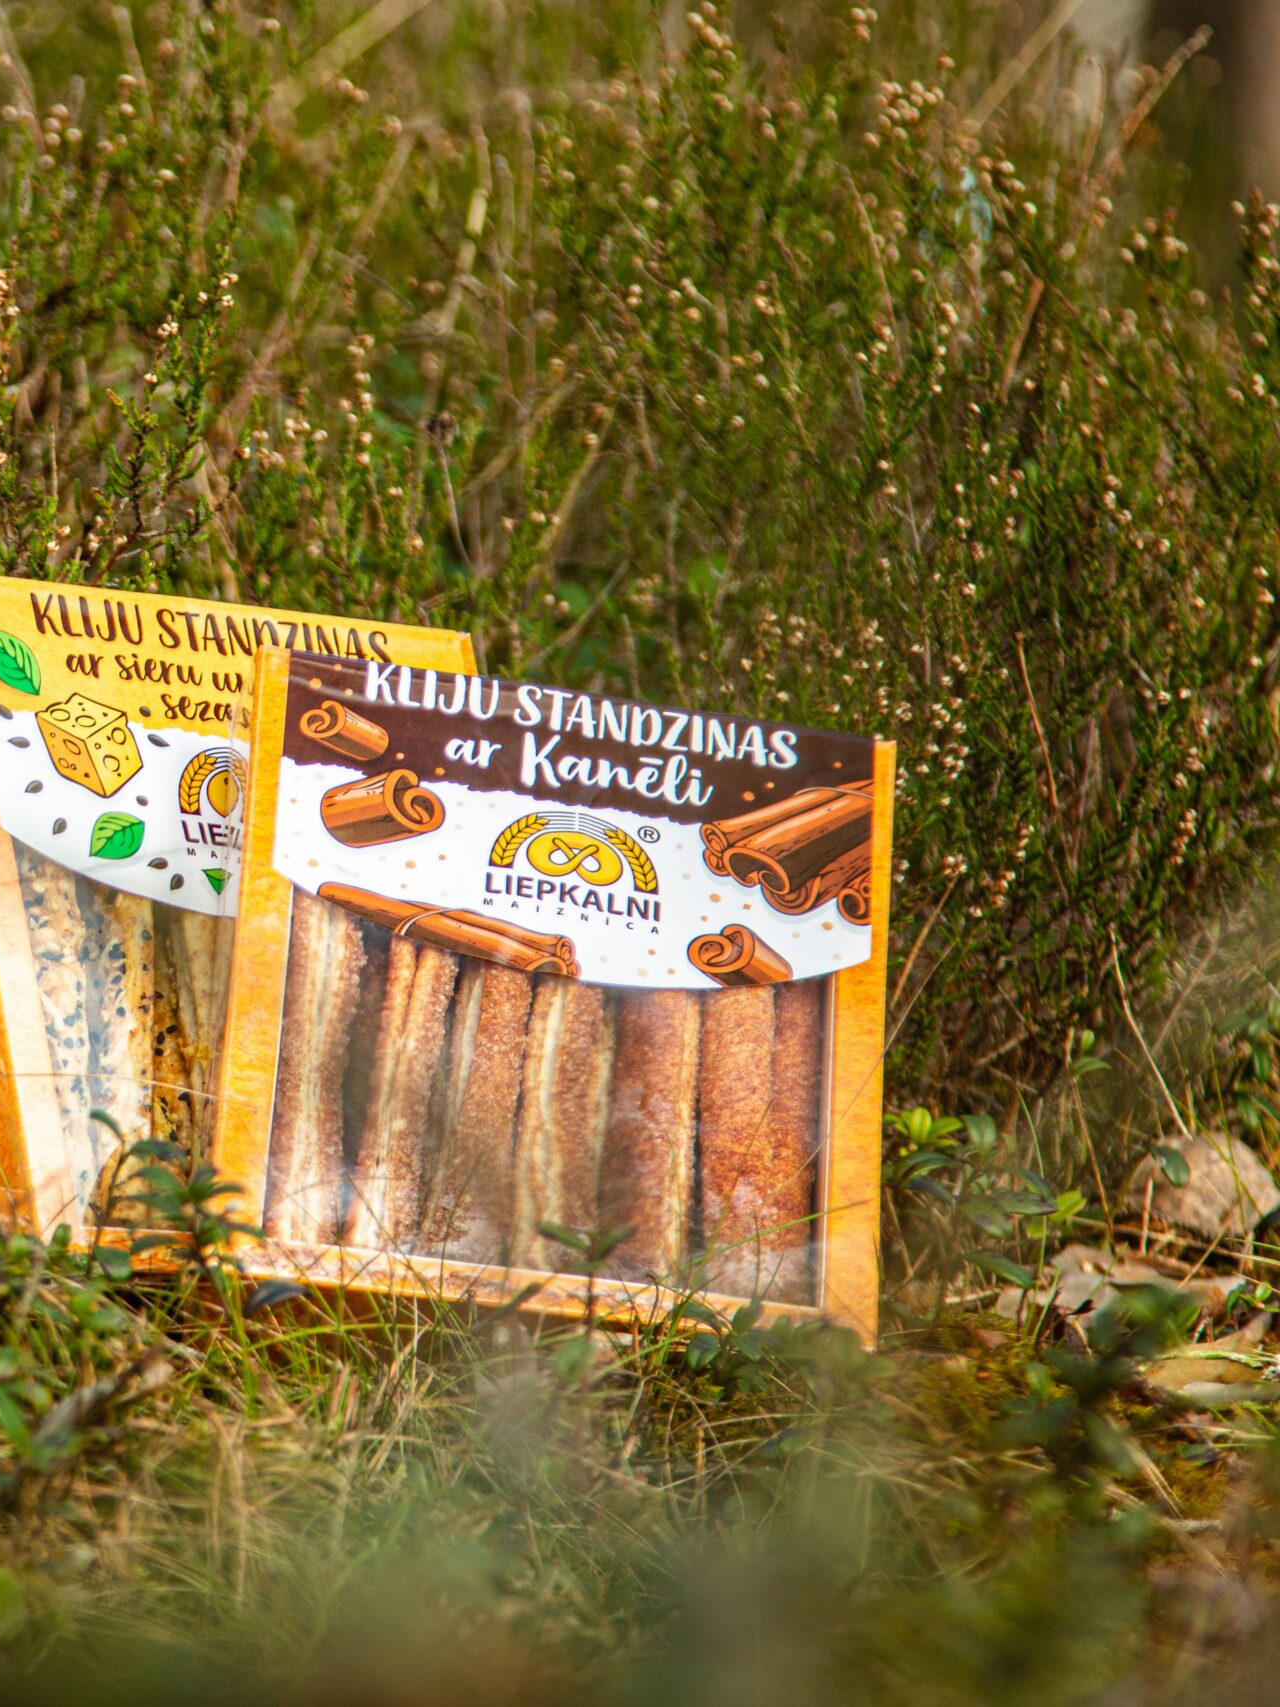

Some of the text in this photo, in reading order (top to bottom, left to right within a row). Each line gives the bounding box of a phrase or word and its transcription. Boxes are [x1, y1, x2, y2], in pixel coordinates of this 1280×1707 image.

[30, 592, 144, 646] KLIJU
[66, 653, 104, 678] ar
[114, 653, 203, 685] sieru
[160, 693, 234, 722] seza
[363, 660, 799, 769] KLIJU STANDZIŅAS
[443, 731, 714, 806] ar Kanēli
[484, 871, 662, 923] LIEPKALNI
